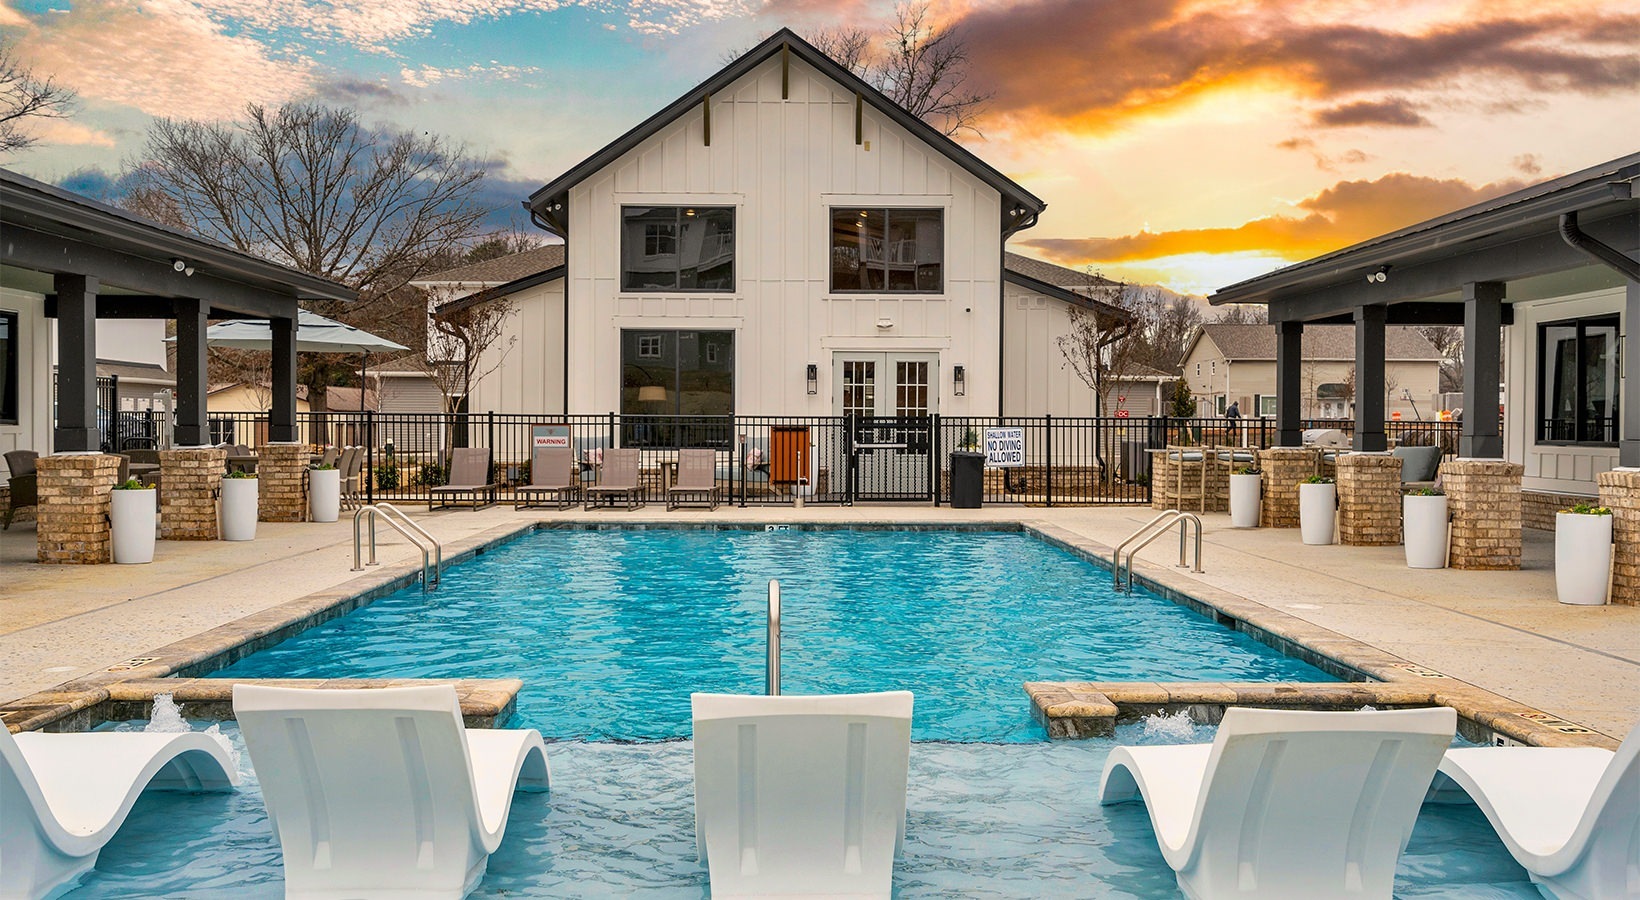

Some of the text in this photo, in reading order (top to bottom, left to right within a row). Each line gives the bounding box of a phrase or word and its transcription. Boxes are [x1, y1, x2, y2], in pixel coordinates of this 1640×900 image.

[987, 431, 1006, 439] SHALLOW
[988, 440, 1021, 451] NO DIVING
[989, 452, 1021, 463] ALLOWED
